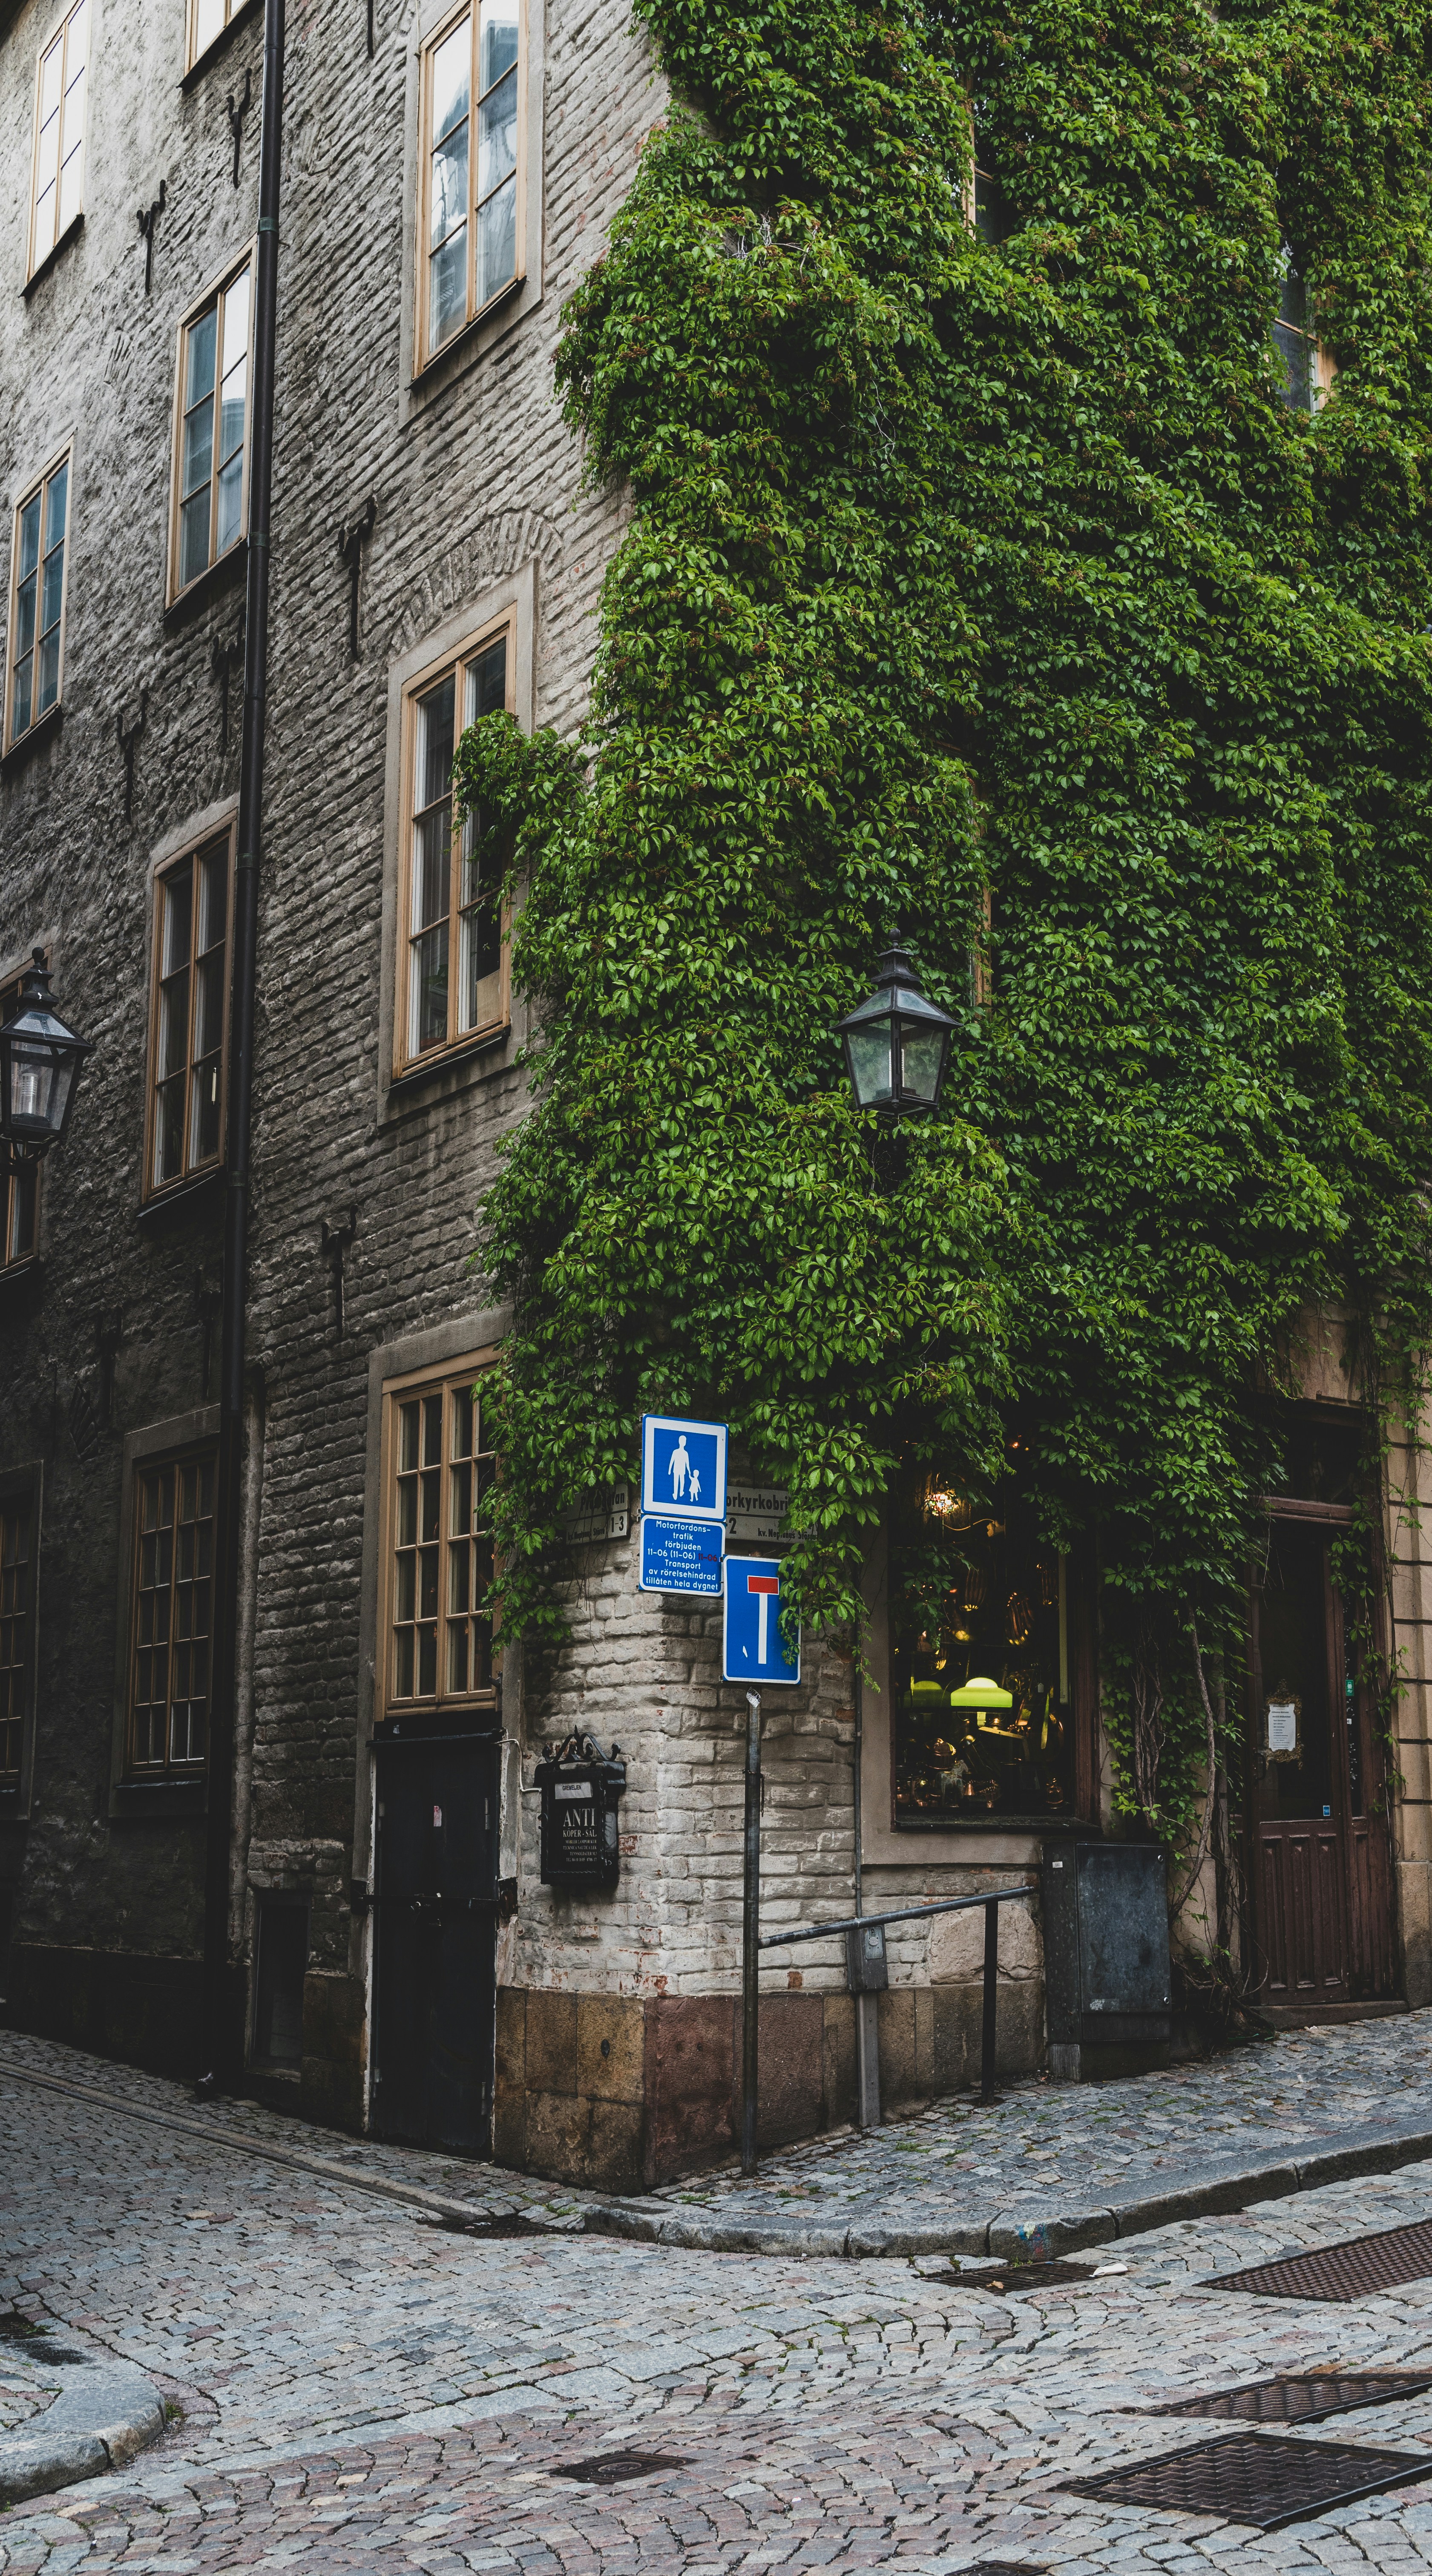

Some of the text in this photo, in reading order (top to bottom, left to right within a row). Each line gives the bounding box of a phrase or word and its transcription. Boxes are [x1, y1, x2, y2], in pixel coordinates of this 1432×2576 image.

[727, 1492, 788, 1512] orkyrkobri
[611, 1515, 624, 1532] 1-3
[656, 1521, 710, 1532] Motorfordons-
[673, 1532, 693, 1541] trafik
[758, 1528, 767, 1537] kv.
[665, 1540, 701, 1551] förbjuden
[647, 1548, 717, 1562] 11-06 (11-06) 11-06
[665, 1559, 701, 1570] Transport
[661, 1569, 716, 1581] rörelsehindrad
[646, 1577, 718, 1590] tillåten hela dygnet
[563, 1808, 597, 1827] ANTI
[563, 1828, 581, 1837] KÖPER
